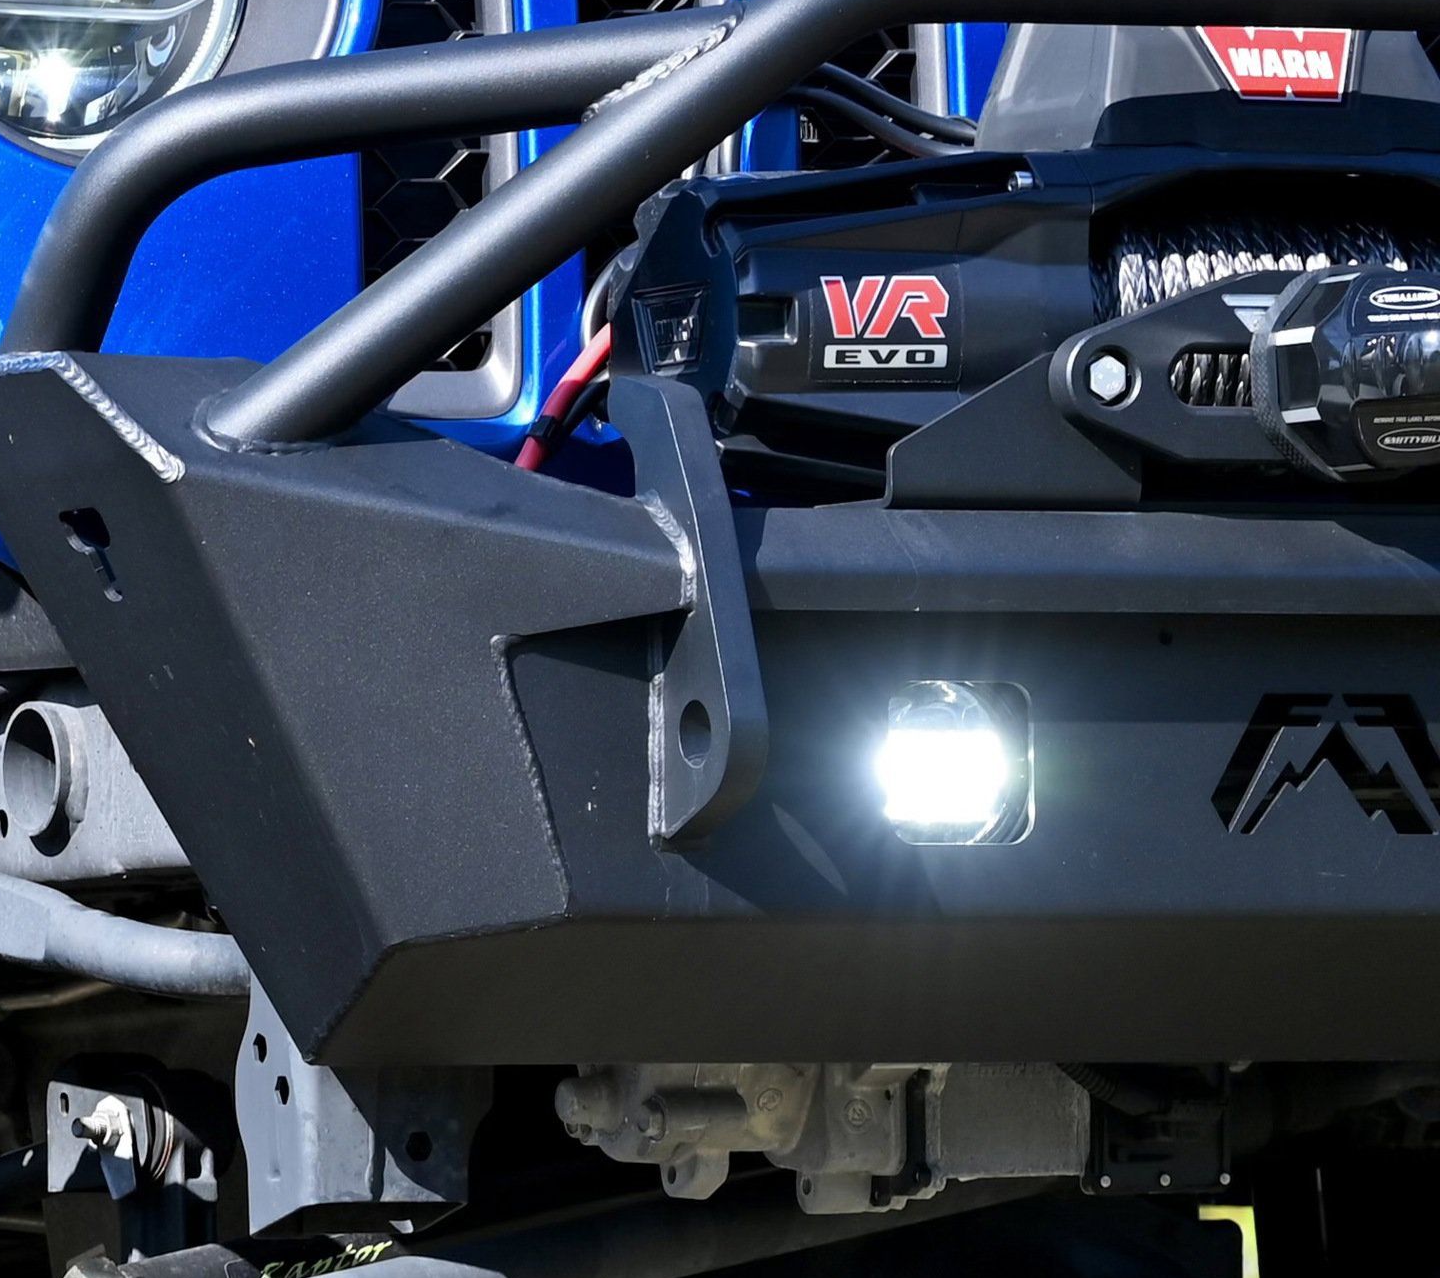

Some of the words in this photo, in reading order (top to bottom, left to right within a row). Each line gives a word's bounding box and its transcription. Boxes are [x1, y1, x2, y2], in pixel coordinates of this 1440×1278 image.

[1228, 48, 1334, 80] WARN
[819, 276, 950, 338] VR
[835, 349, 935, 365] EVO
